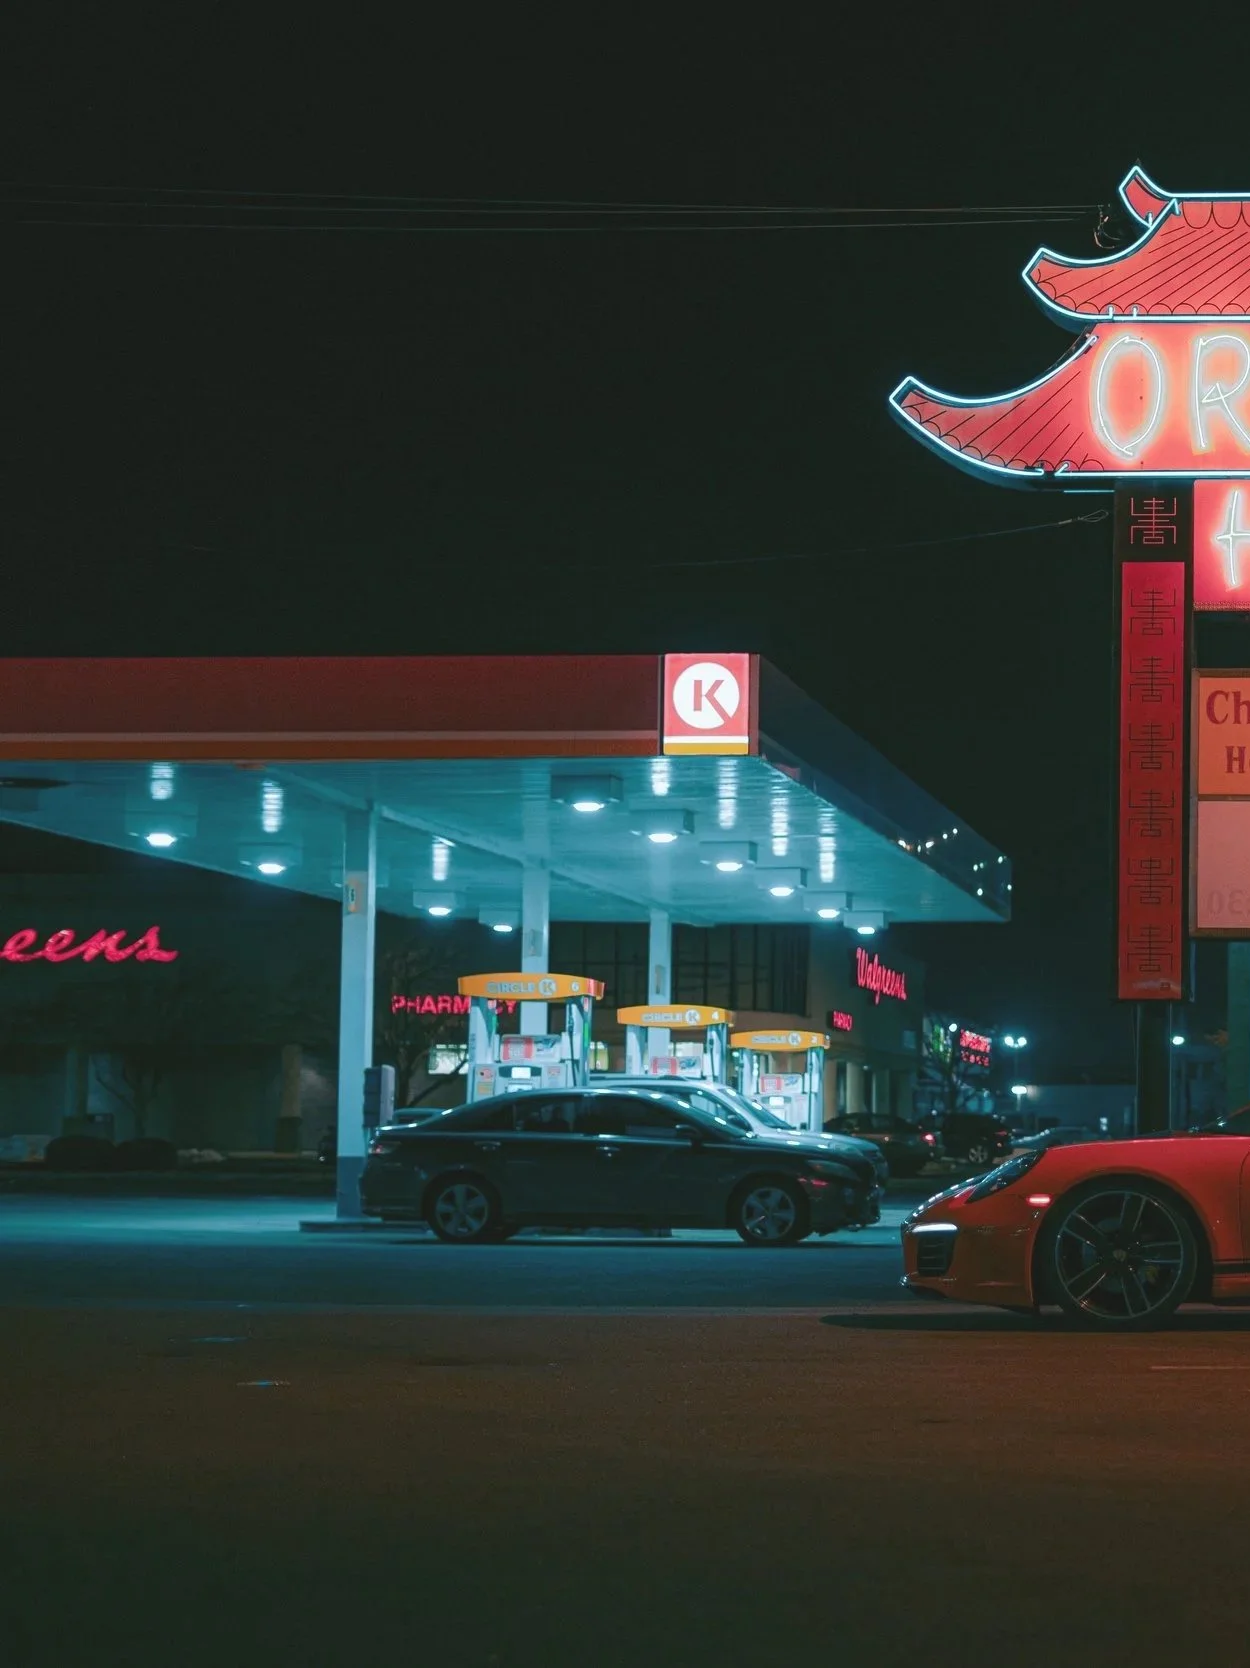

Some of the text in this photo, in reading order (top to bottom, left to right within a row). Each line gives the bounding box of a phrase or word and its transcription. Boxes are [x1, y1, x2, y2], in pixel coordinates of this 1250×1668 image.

[693, 679, 733, 720] K
[486, 981, 536, 993] CIRCLE
[856, 947, 908, 1005] Walgreens
[391, 995, 517, 1015] PHARMCY
